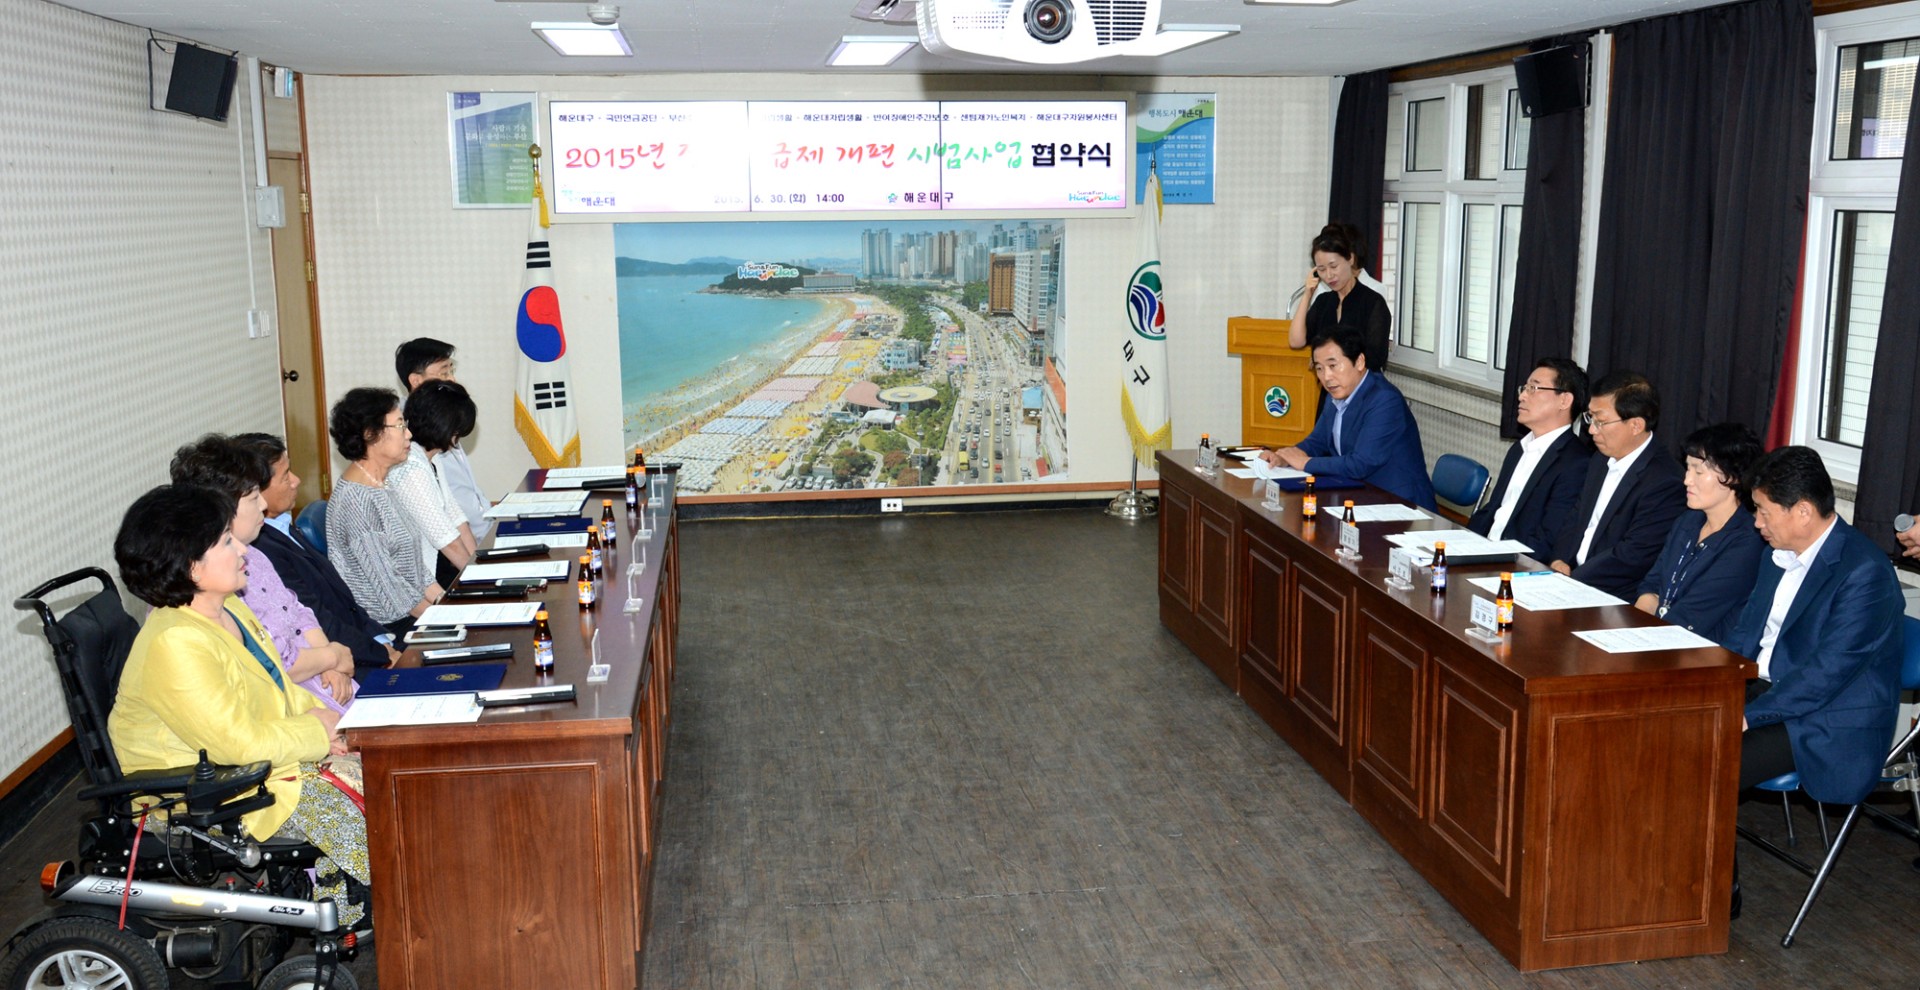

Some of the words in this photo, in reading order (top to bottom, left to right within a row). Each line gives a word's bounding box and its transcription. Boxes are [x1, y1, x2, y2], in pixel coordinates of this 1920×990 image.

[558, 114, 594, 122] 해운대구
[606, 114, 657, 122] 국민연금공단
[565, 142, 665, 170] 2015년
[836, 143, 894, 168] 개편
[907, 142, 1022, 169] 시범사업
[1031, 142, 1111, 168] 협약식
[789, 193, 806, 204] (화)
[817, 194, 844, 202] 14:00
